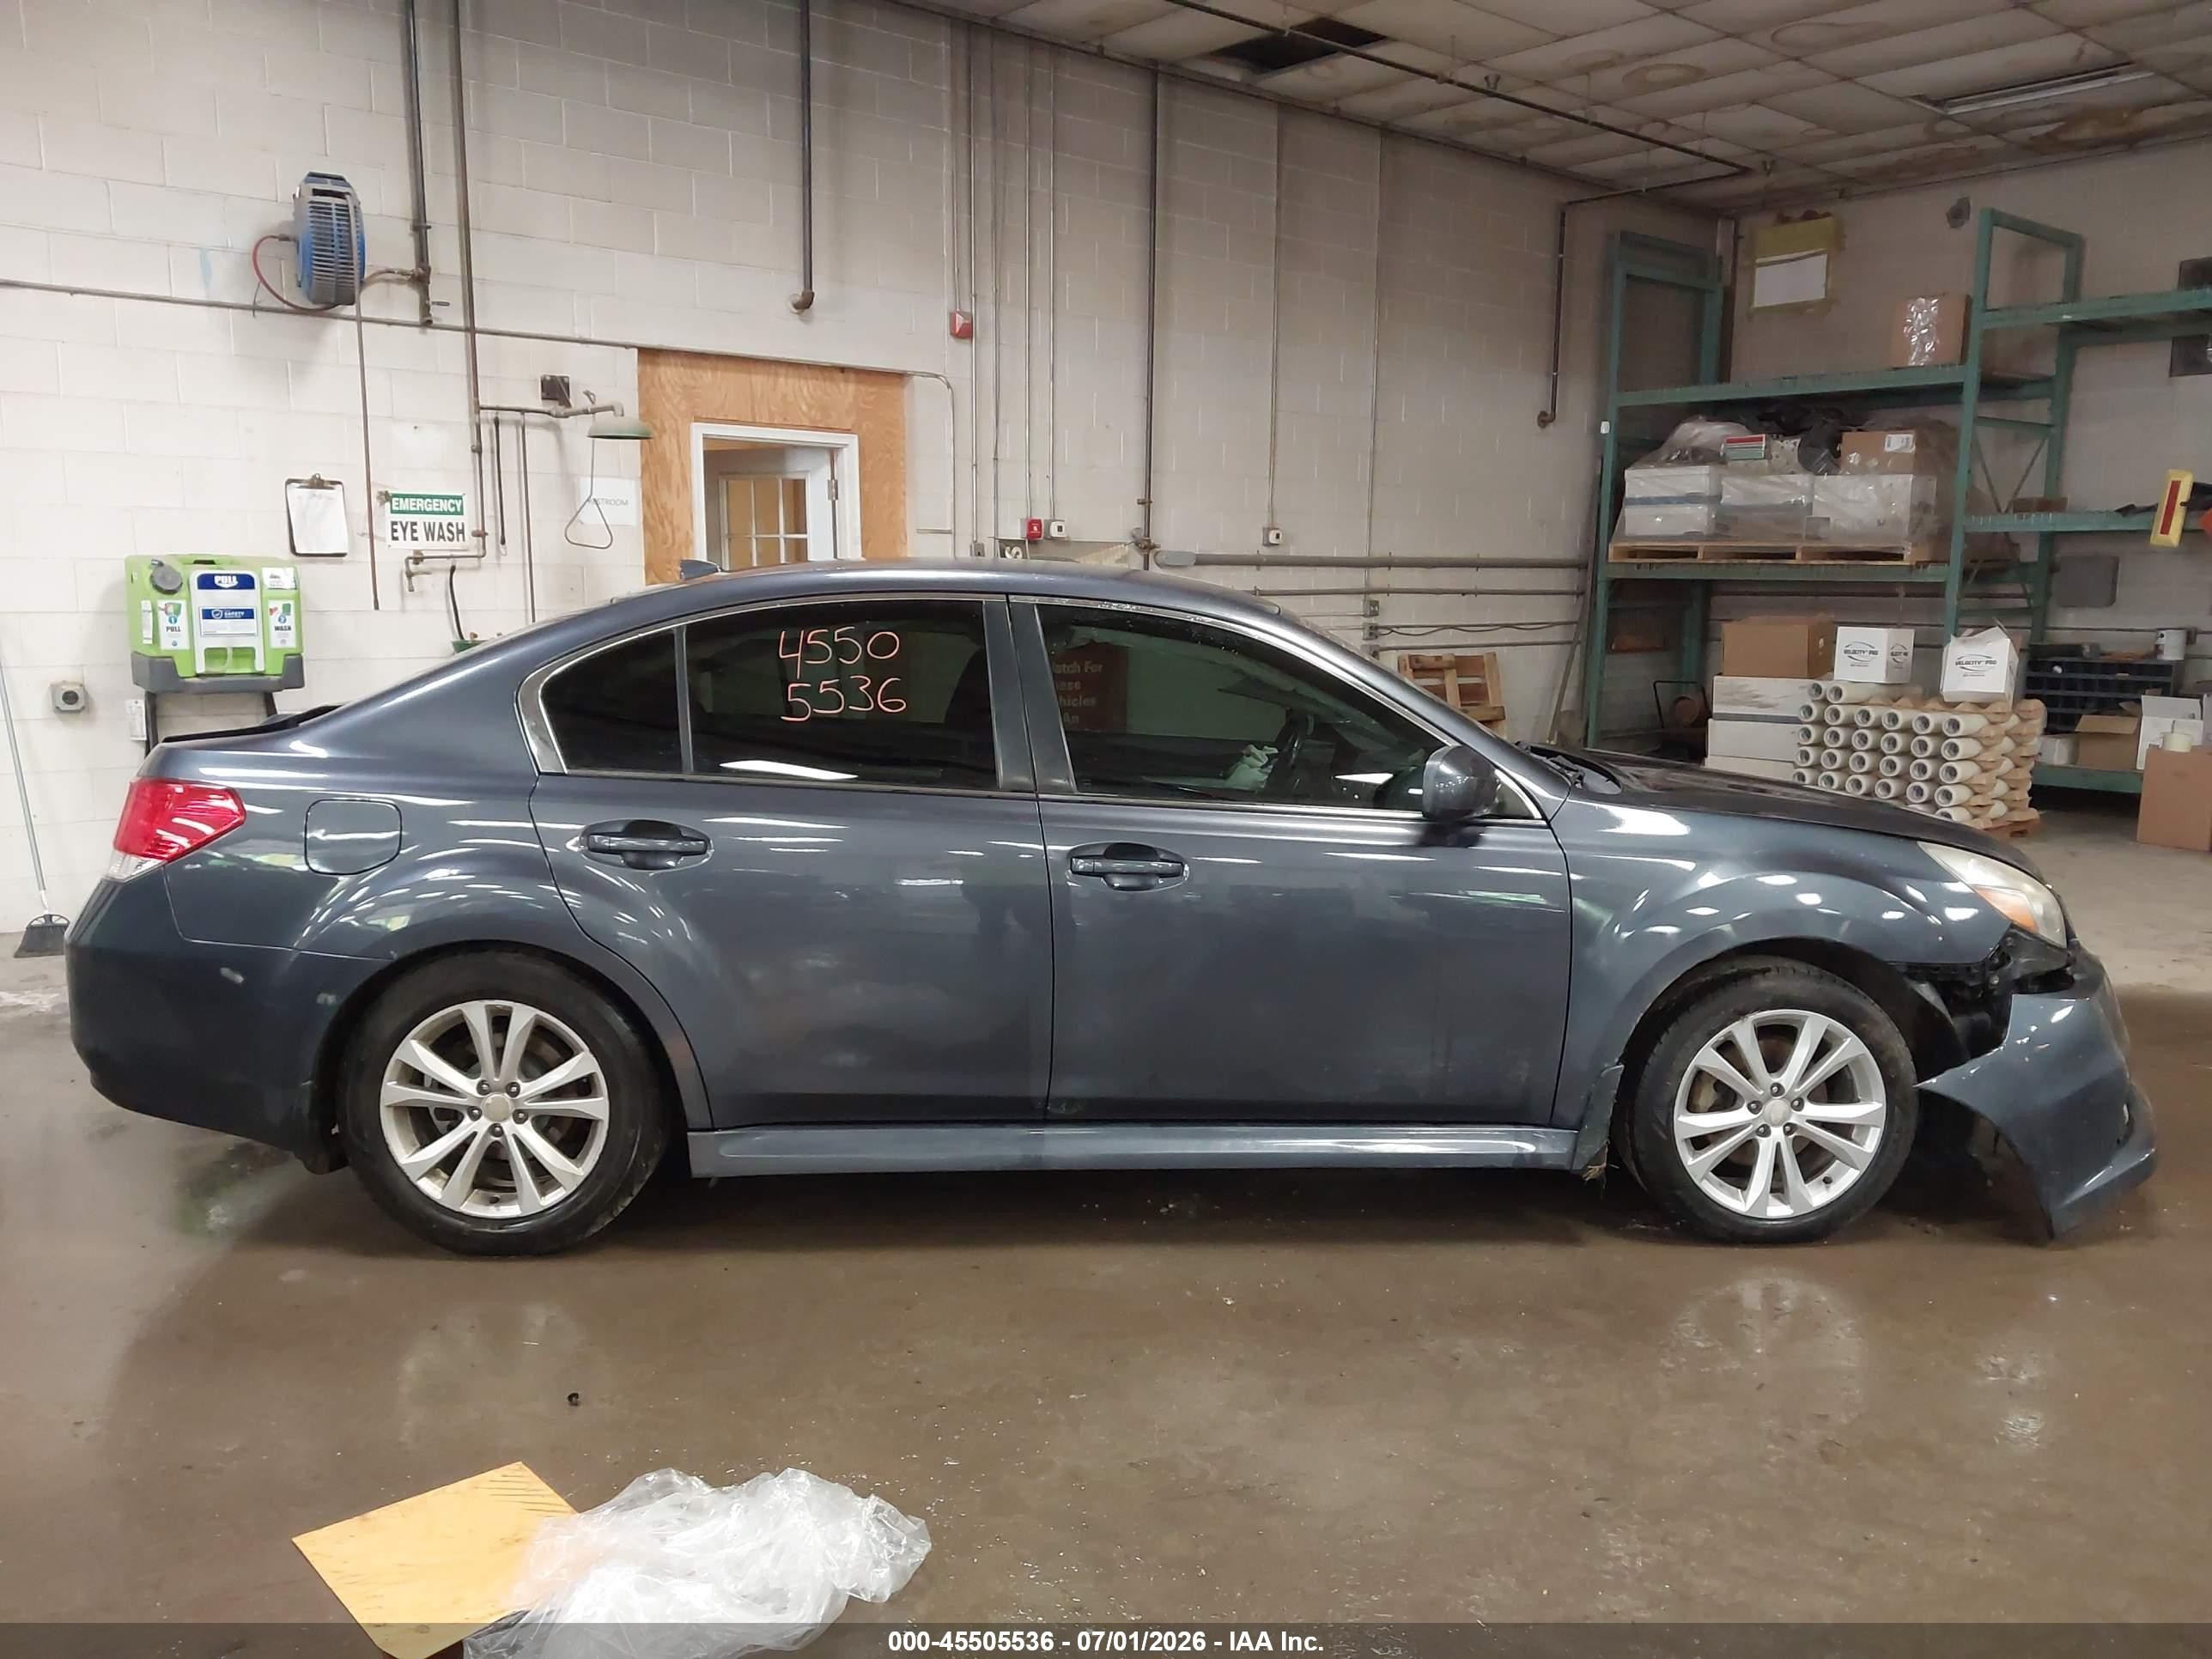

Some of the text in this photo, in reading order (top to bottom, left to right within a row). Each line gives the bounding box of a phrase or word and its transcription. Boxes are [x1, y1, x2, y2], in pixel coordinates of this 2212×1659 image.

[392, 497, 462, 512] EMERGENCY
[391, 520, 465, 542] EYE WASH
[214, 575, 238, 585] PULL
[778, 626, 900, 680] 4550
[1085, 660, 1103, 673] For
[780, 675, 907, 721] 5536
[1059, 695, 1097, 708] hicles
